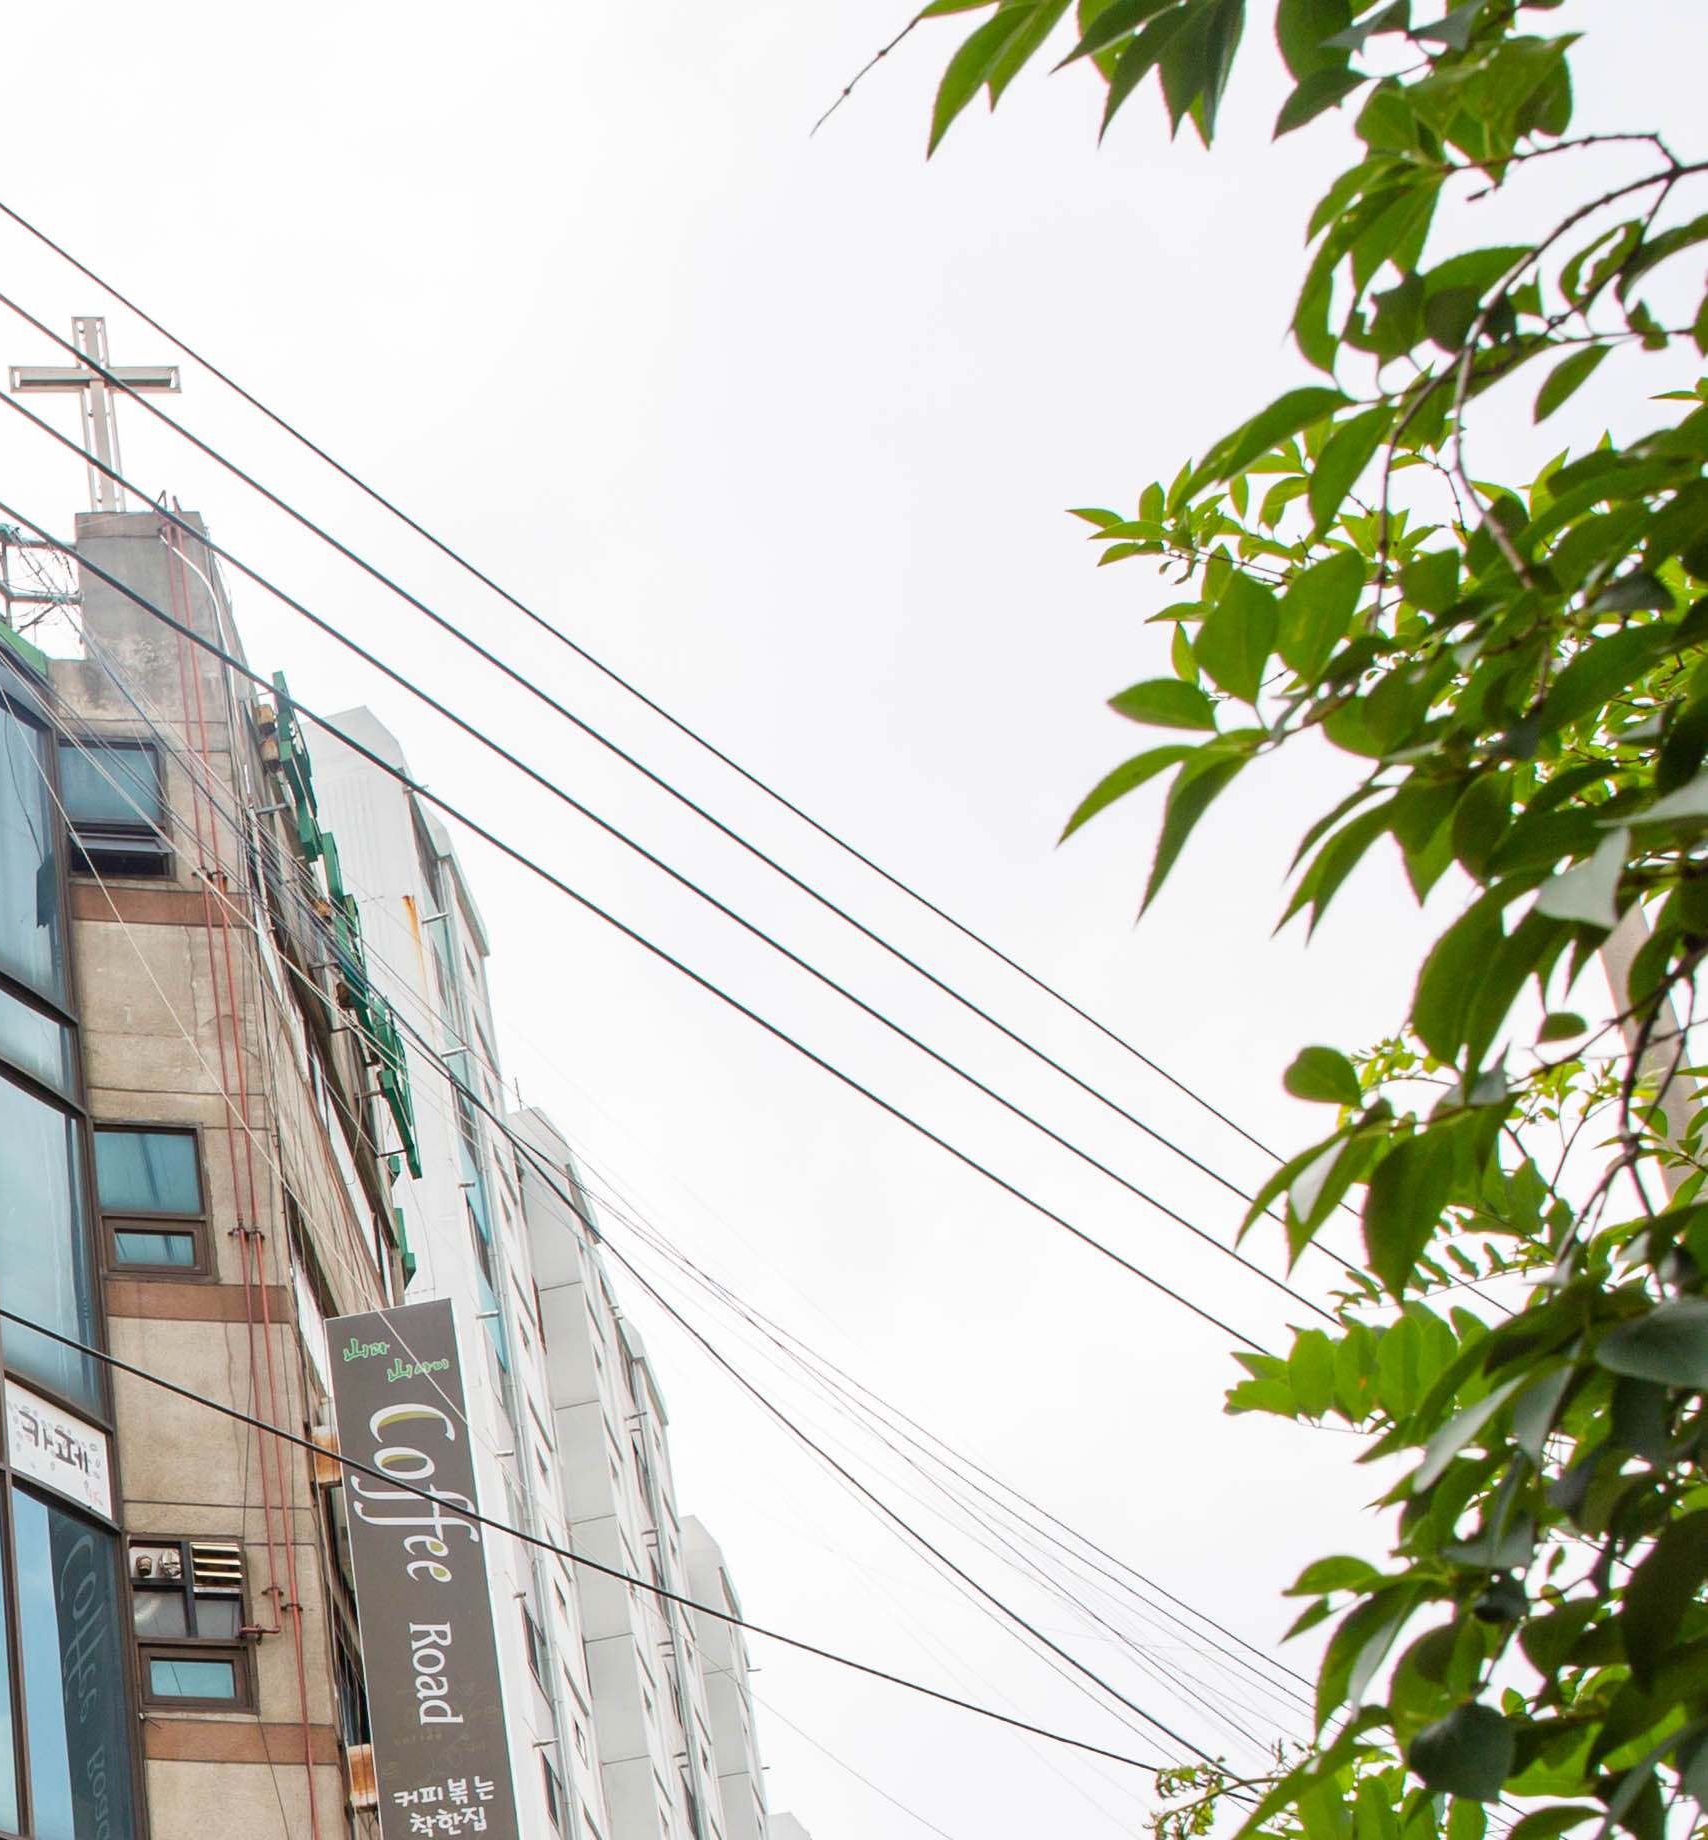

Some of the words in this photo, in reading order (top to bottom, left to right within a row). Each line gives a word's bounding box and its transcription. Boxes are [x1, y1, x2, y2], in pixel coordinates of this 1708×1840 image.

[18, 1410, 89, 1474] 카페
[350, 1402, 479, 1585] Coffee
[408, 1621, 463, 1726] Road
